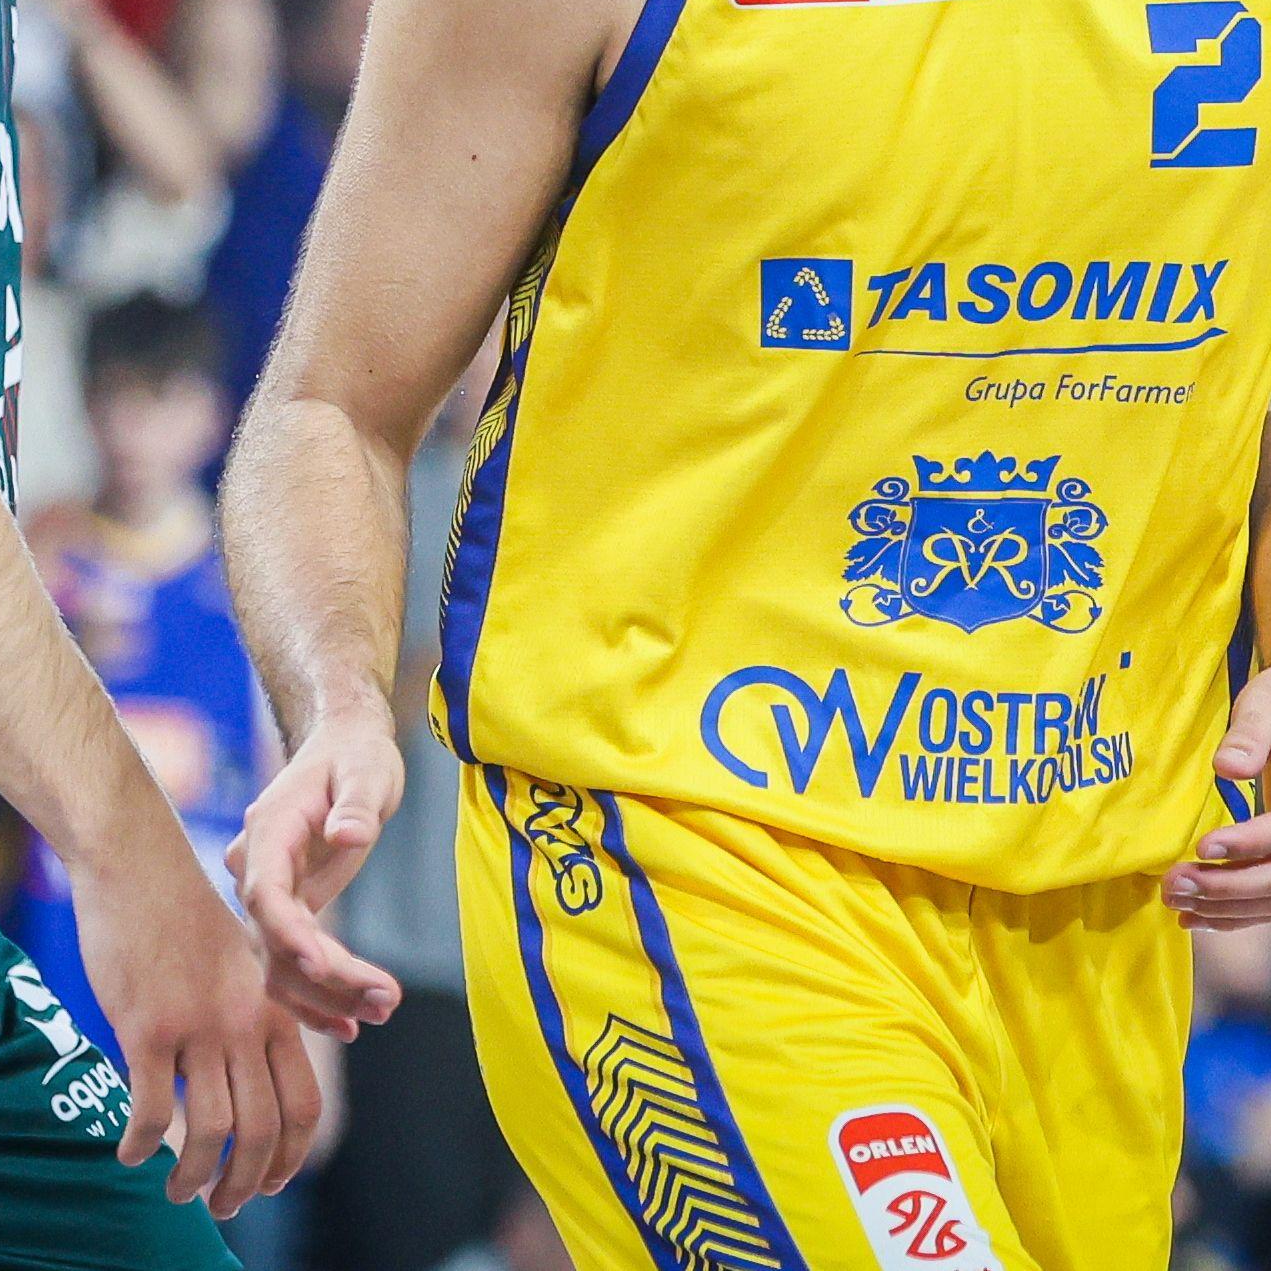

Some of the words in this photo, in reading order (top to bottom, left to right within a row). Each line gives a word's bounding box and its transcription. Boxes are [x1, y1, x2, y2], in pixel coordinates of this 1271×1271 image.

[1145, 1, 1262, 168] 2
[866, 258, 1230, 330] TASOMIX
[964, 375, 1046, 408] Grupa
[917, 672, 1110, 757] OSTRW
[899, 730, 1134, 805] WIELKOOLSKI
[848, 1134, 936, 1164] ORLEN
